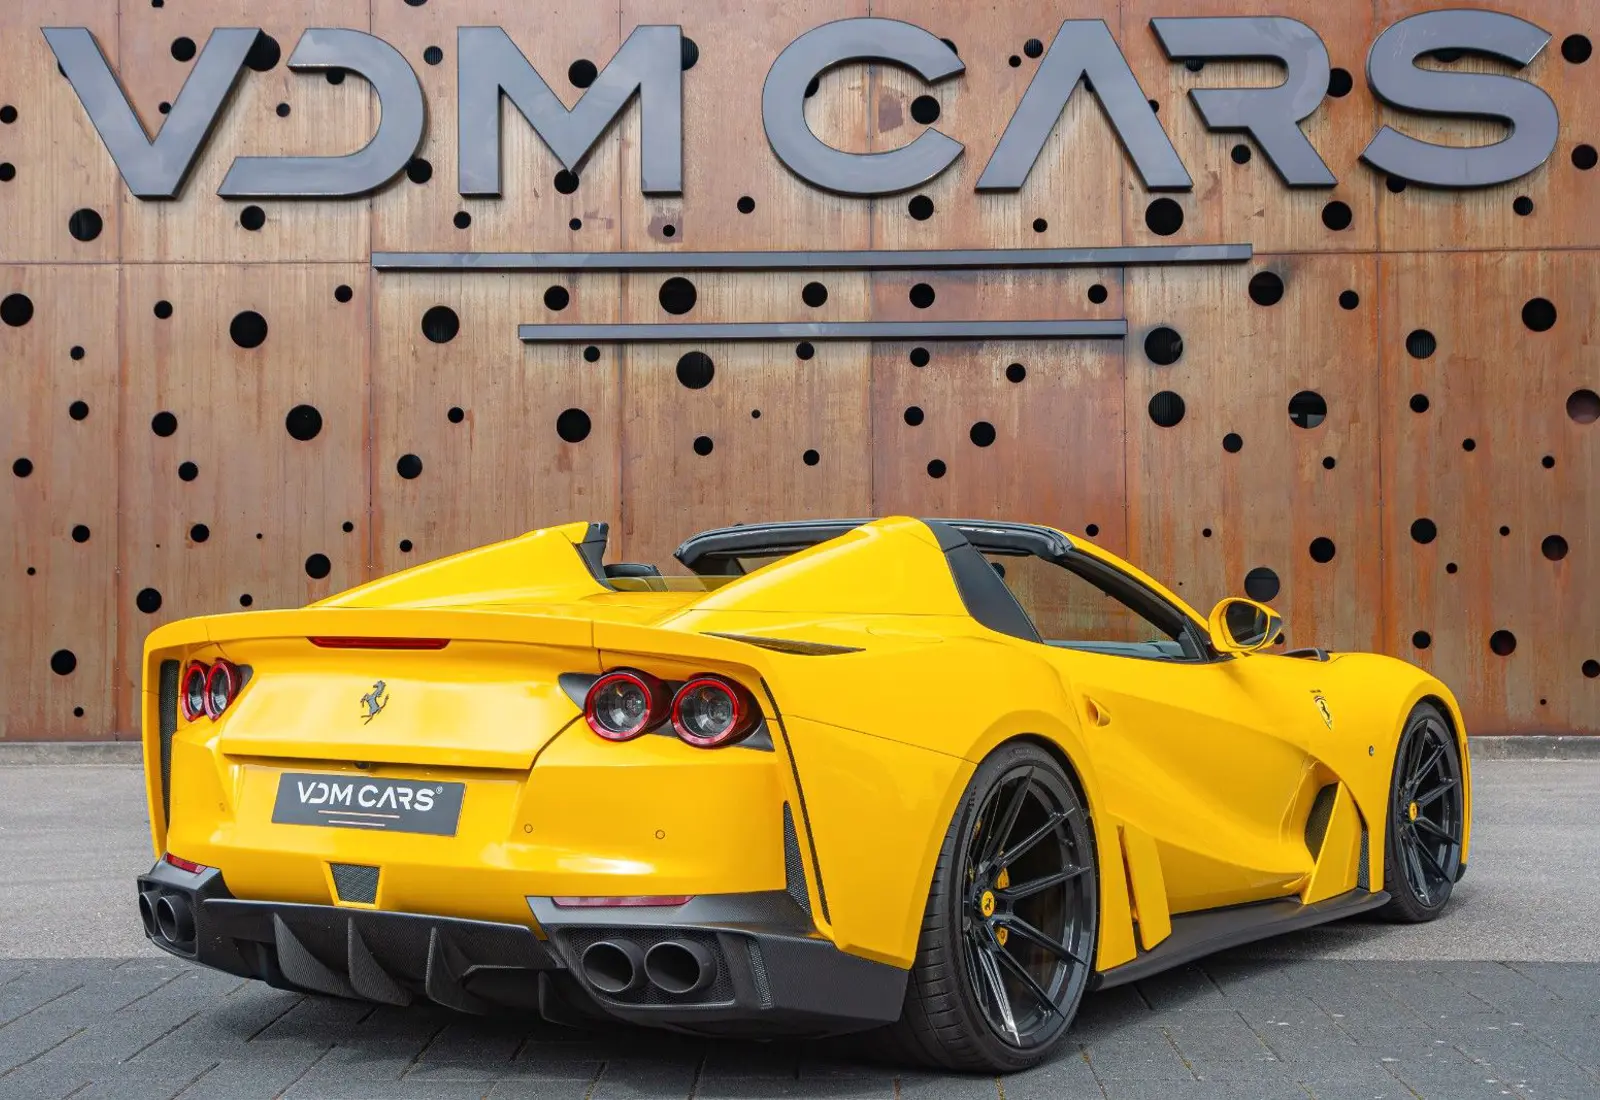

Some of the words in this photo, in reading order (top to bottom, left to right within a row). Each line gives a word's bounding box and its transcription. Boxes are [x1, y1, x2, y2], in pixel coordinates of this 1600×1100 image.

[41, 25, 683, 200] VDM
[761, 9, 1560, 195] CARS
[297, 781, 354, 806] VDM
